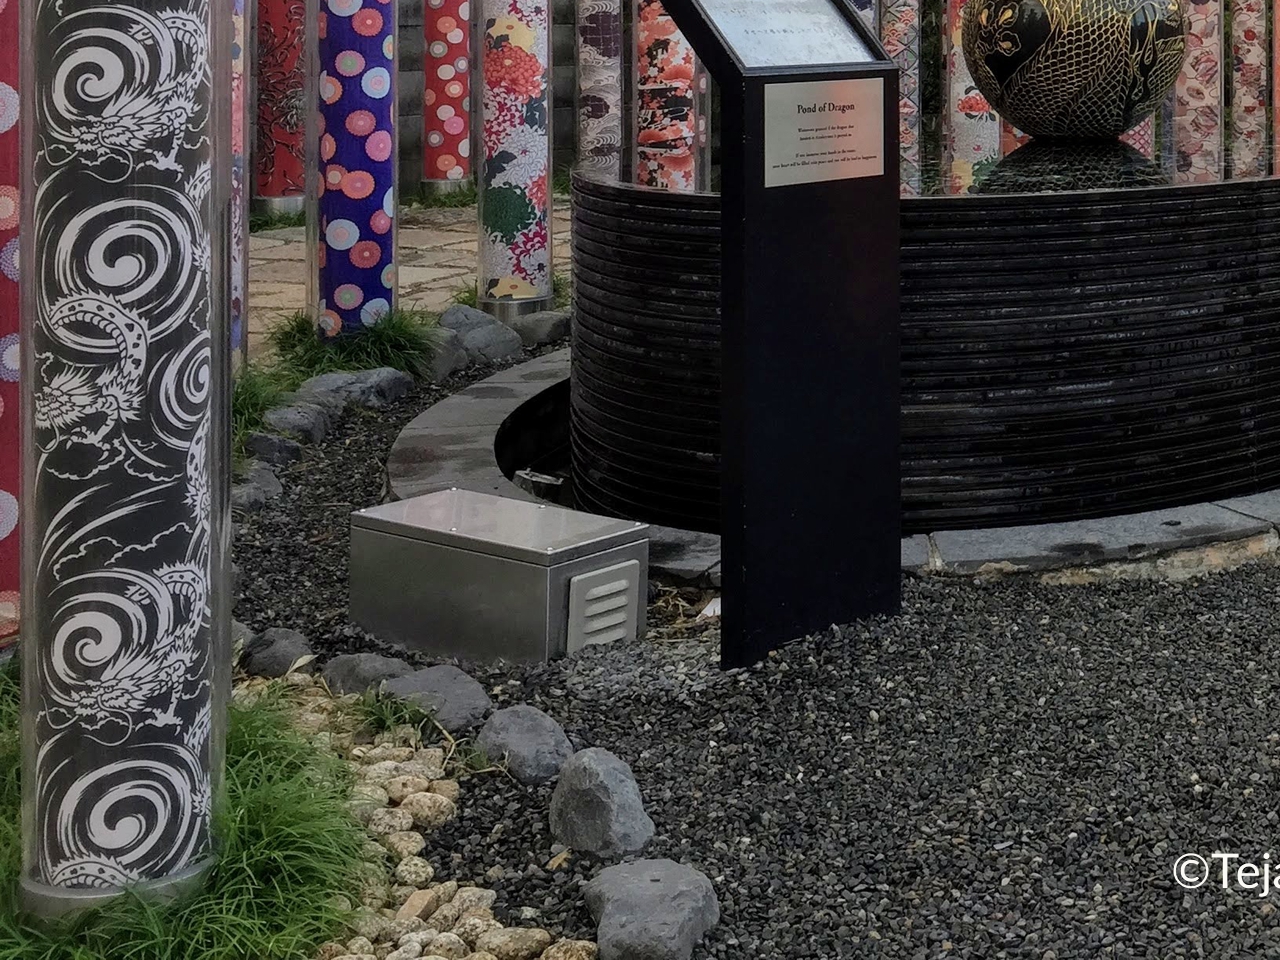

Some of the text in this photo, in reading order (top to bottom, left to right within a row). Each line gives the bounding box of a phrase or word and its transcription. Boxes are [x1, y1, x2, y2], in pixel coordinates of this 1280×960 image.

[797, 102, 855, 114] Pond of Dragon
